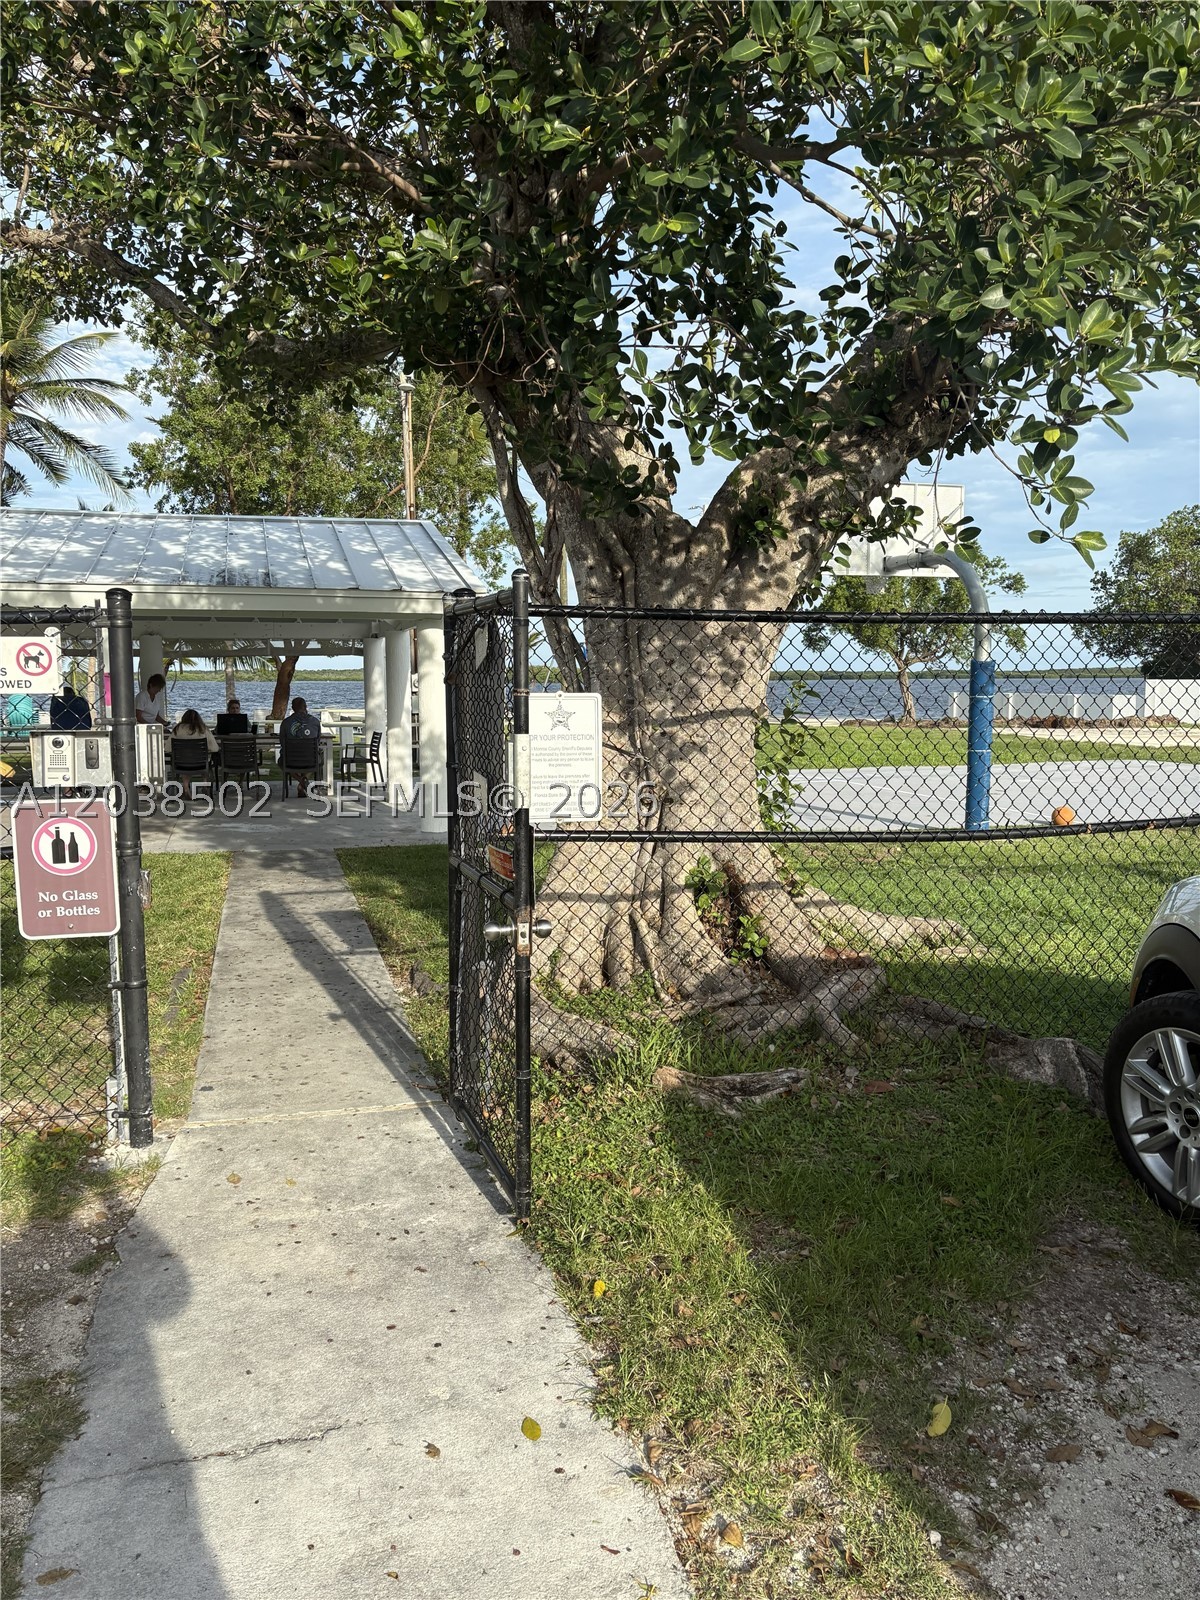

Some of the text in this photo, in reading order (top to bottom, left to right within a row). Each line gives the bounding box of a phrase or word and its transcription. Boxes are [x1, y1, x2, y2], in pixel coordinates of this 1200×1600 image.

[38, 889, 99, 903] No Glass
[37, 905, 101, 919] or Bottles
